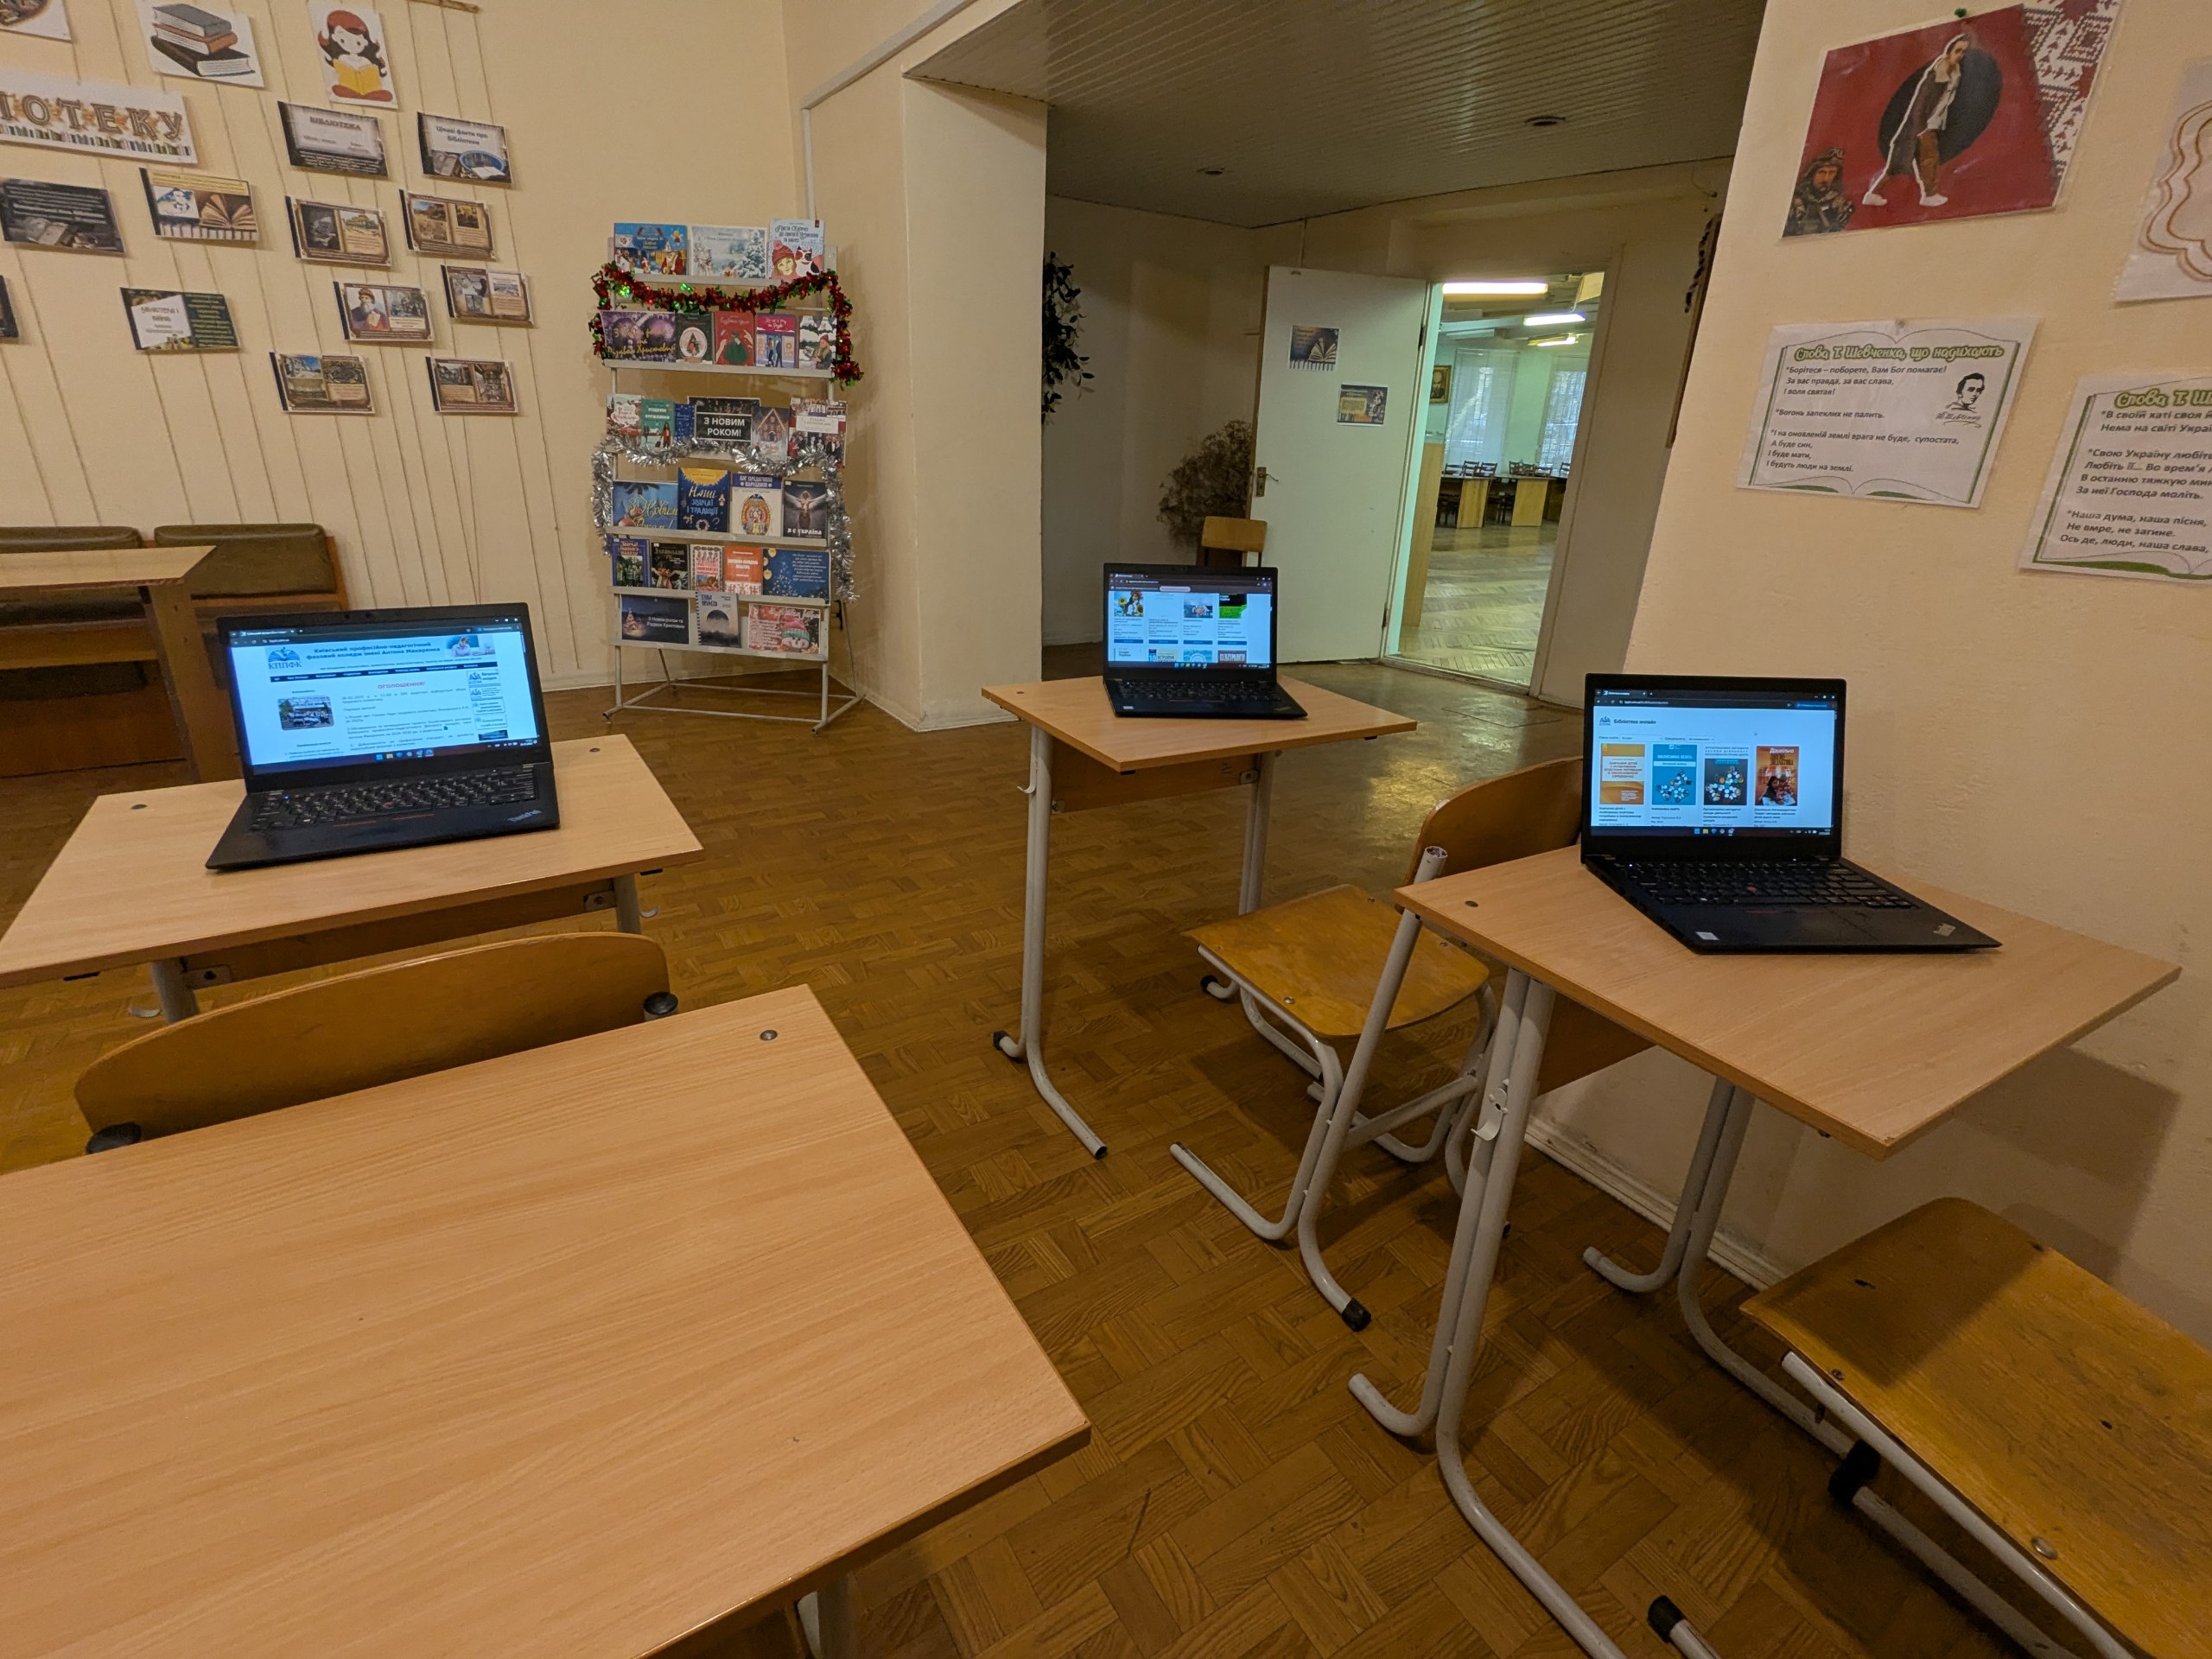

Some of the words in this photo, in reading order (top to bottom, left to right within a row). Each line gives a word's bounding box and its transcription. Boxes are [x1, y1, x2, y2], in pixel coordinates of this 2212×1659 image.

[1795, 344, 1830, 361] Слова
[1844, 344, 1907, 361] Шевченка,
[1910, 346, 1930, 362] що
[1932, 345, 2005, 363] надихають
[1906, 365, 1947, 374] помагає!
[2113, 387, 2169, 409] Слова
[2116, 410, 2146, 419] своїй
[712, 417, 745, 427] НОВИМ
[707, 428, 742, 437] РОКОМ!
[2101, 423, 2132, 432] Нема
[1778, 440, 1796, 448] буде
[1887, 434, 1910, 443] буде,
[1915, 436, 1959, 445] супостата,
[1772, 449, 1789, 458] буде
[2126, 448, 2171, 460] Україну
[1770, 461, 1795, 469] будуть
[2084, 461, 2124, 470] Любіть
[2090, 475, 2139, 484] останню
[2141, 478, 2187, 486] тяжкую
[2075, 486, 2089, 494] За
[2091, 486, 2109, 495] неї
[2109, 487, 2158, 498] Господа
[2161, 490, 2204, 499] моліть.
[691, 498, 714, 506] ЗВИЧАЇ
[690, 506, 719, 516] ТРАДИЦІЇ
[2102, 512, 2136, 523] дума,
[2139, 516, 2170, 524] наша
[2172, 517, 2208, 527] пісня,
[2083, 524, 2114, 534] вмре,
[2134, 528, 2177, 537] загине.
[2060, 534, 2079, 543] Ось
[2081, 537, 2099, 545] де,
[2101, 538, 2136, 548] люди,
[2139, 541, 2170, 550] наша
[2172, 543, 2209, 554] слава,
[349, 641, 431, 652] професійно-педагогічний
[268, 661, 302, 670] КППФК
